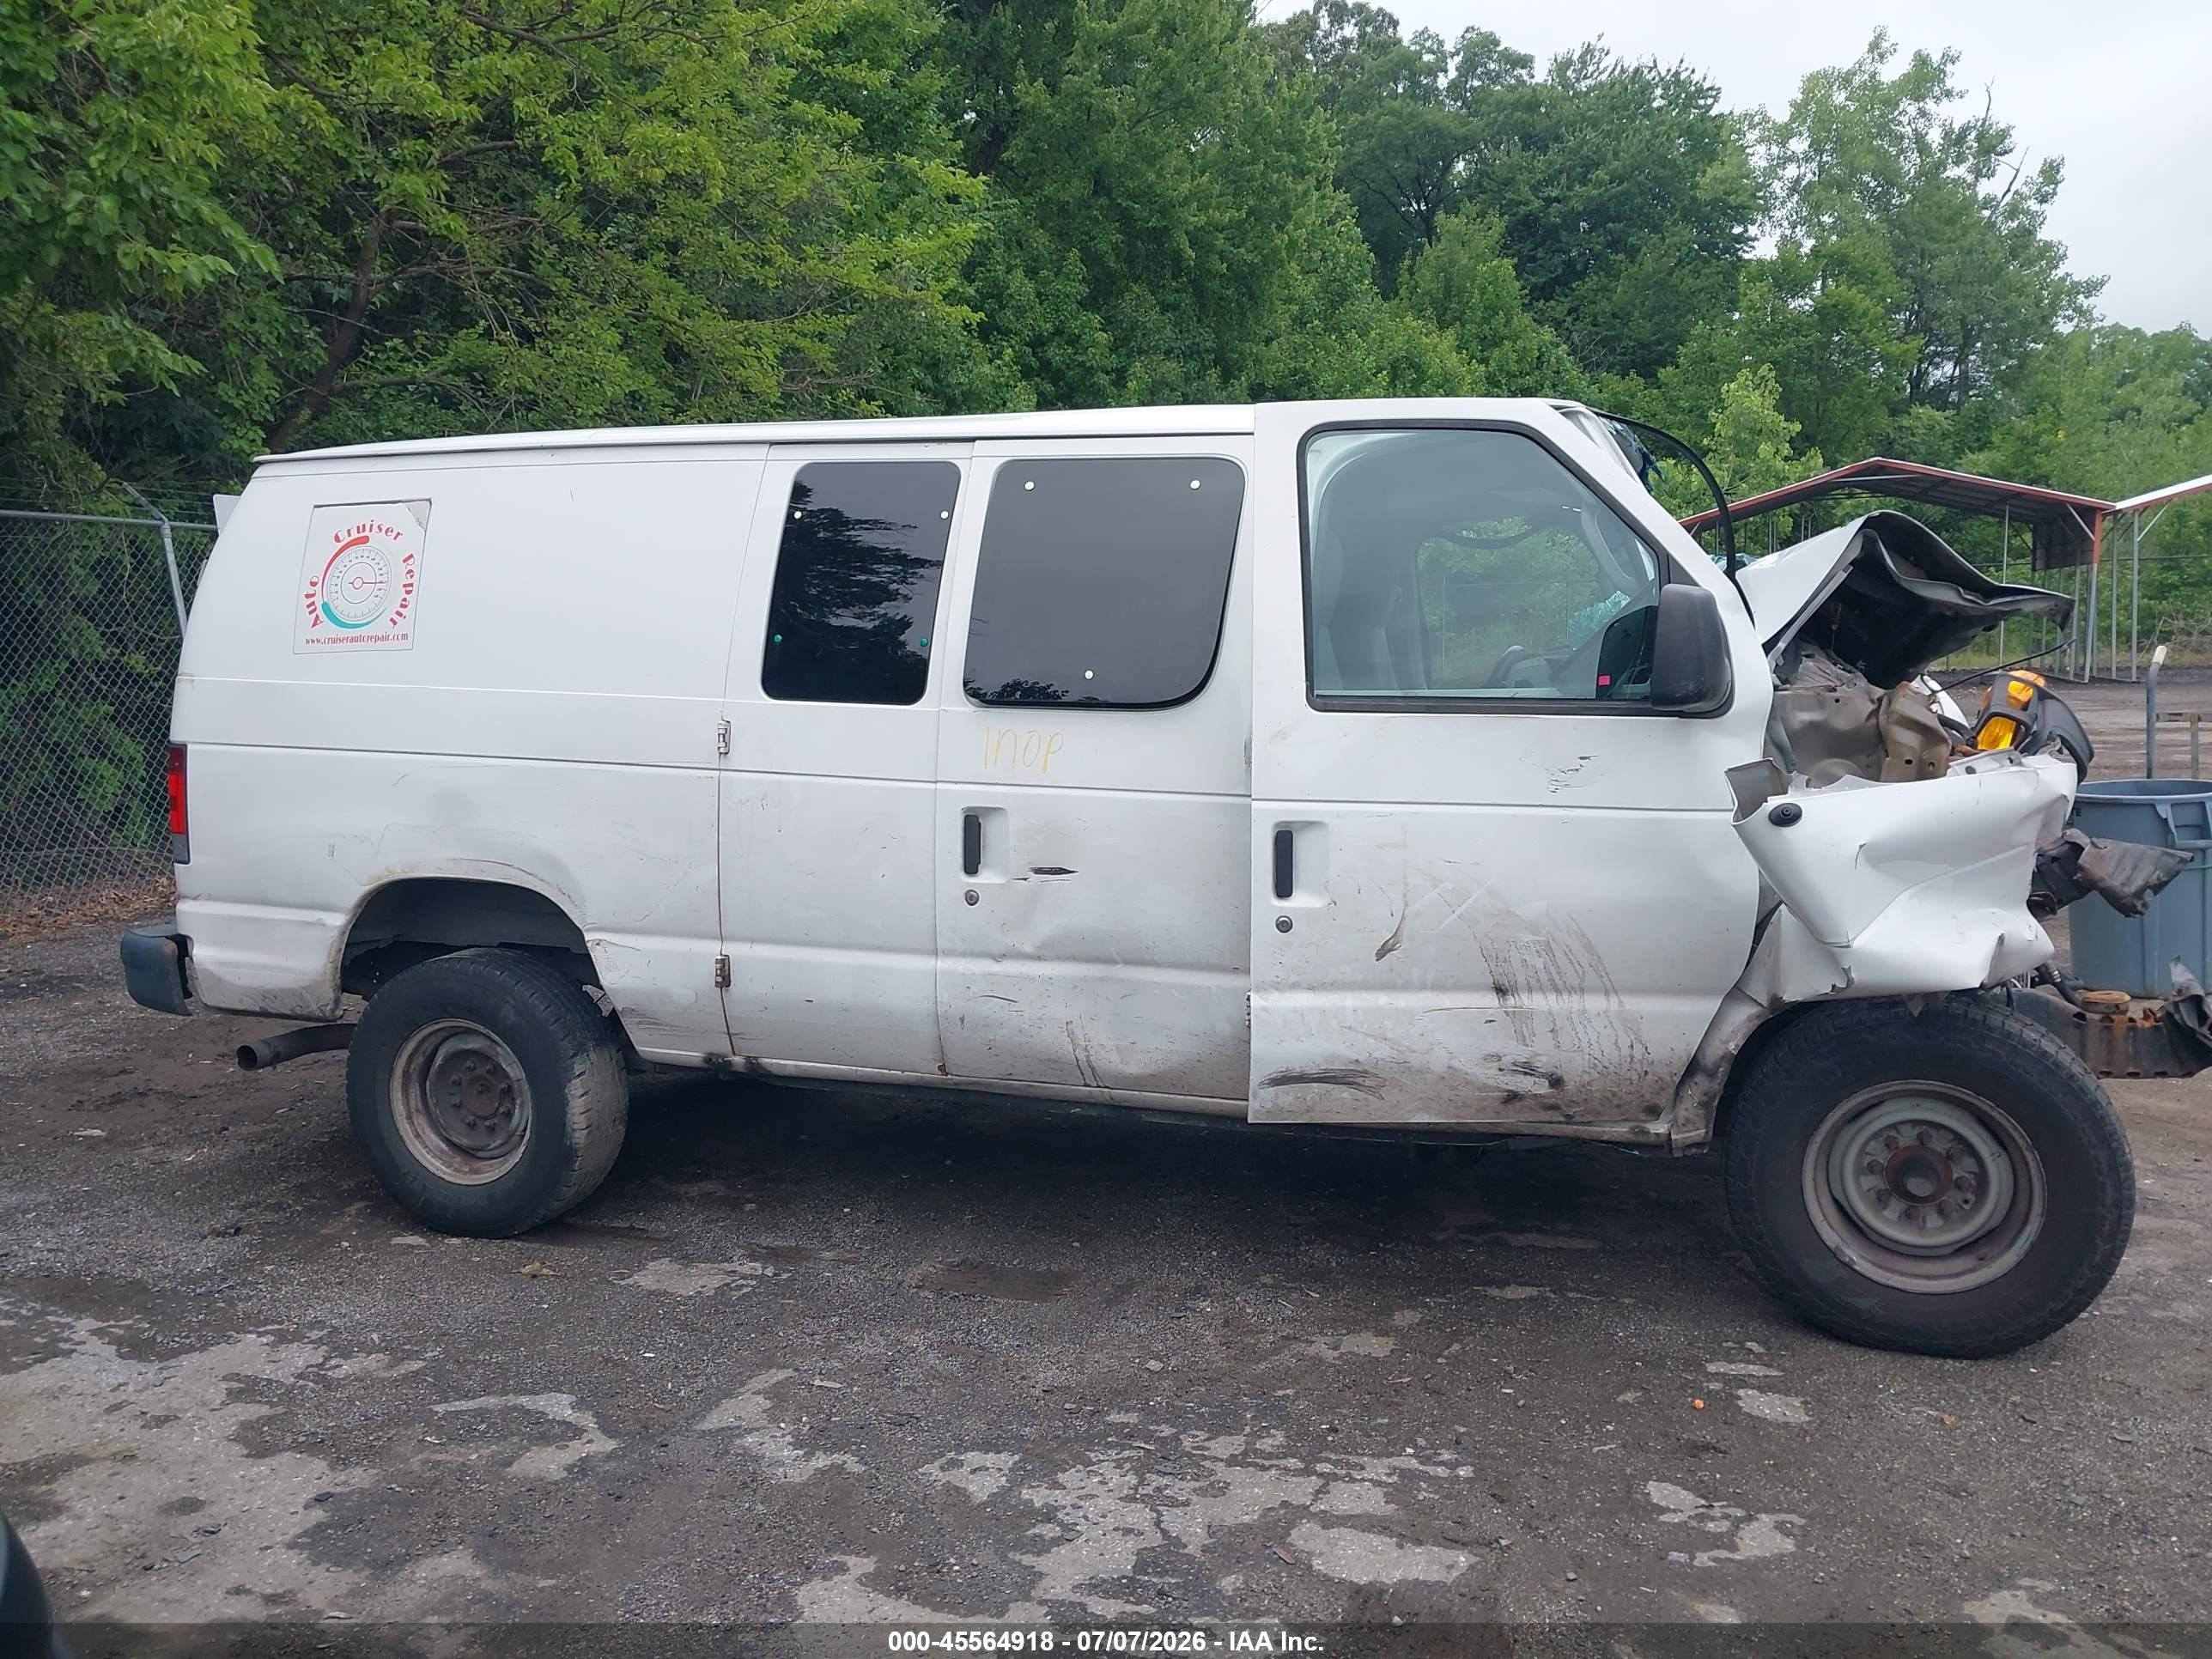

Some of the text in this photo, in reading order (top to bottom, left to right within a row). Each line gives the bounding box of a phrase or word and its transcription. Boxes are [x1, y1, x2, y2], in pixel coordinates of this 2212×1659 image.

[334, 520, 404, 543] Cruiser
[304, 576, 324, 629] Auto
[389, 553, 416, 629] Repair
[305, 632, 409, 646] www.cruiserautorepair.com
